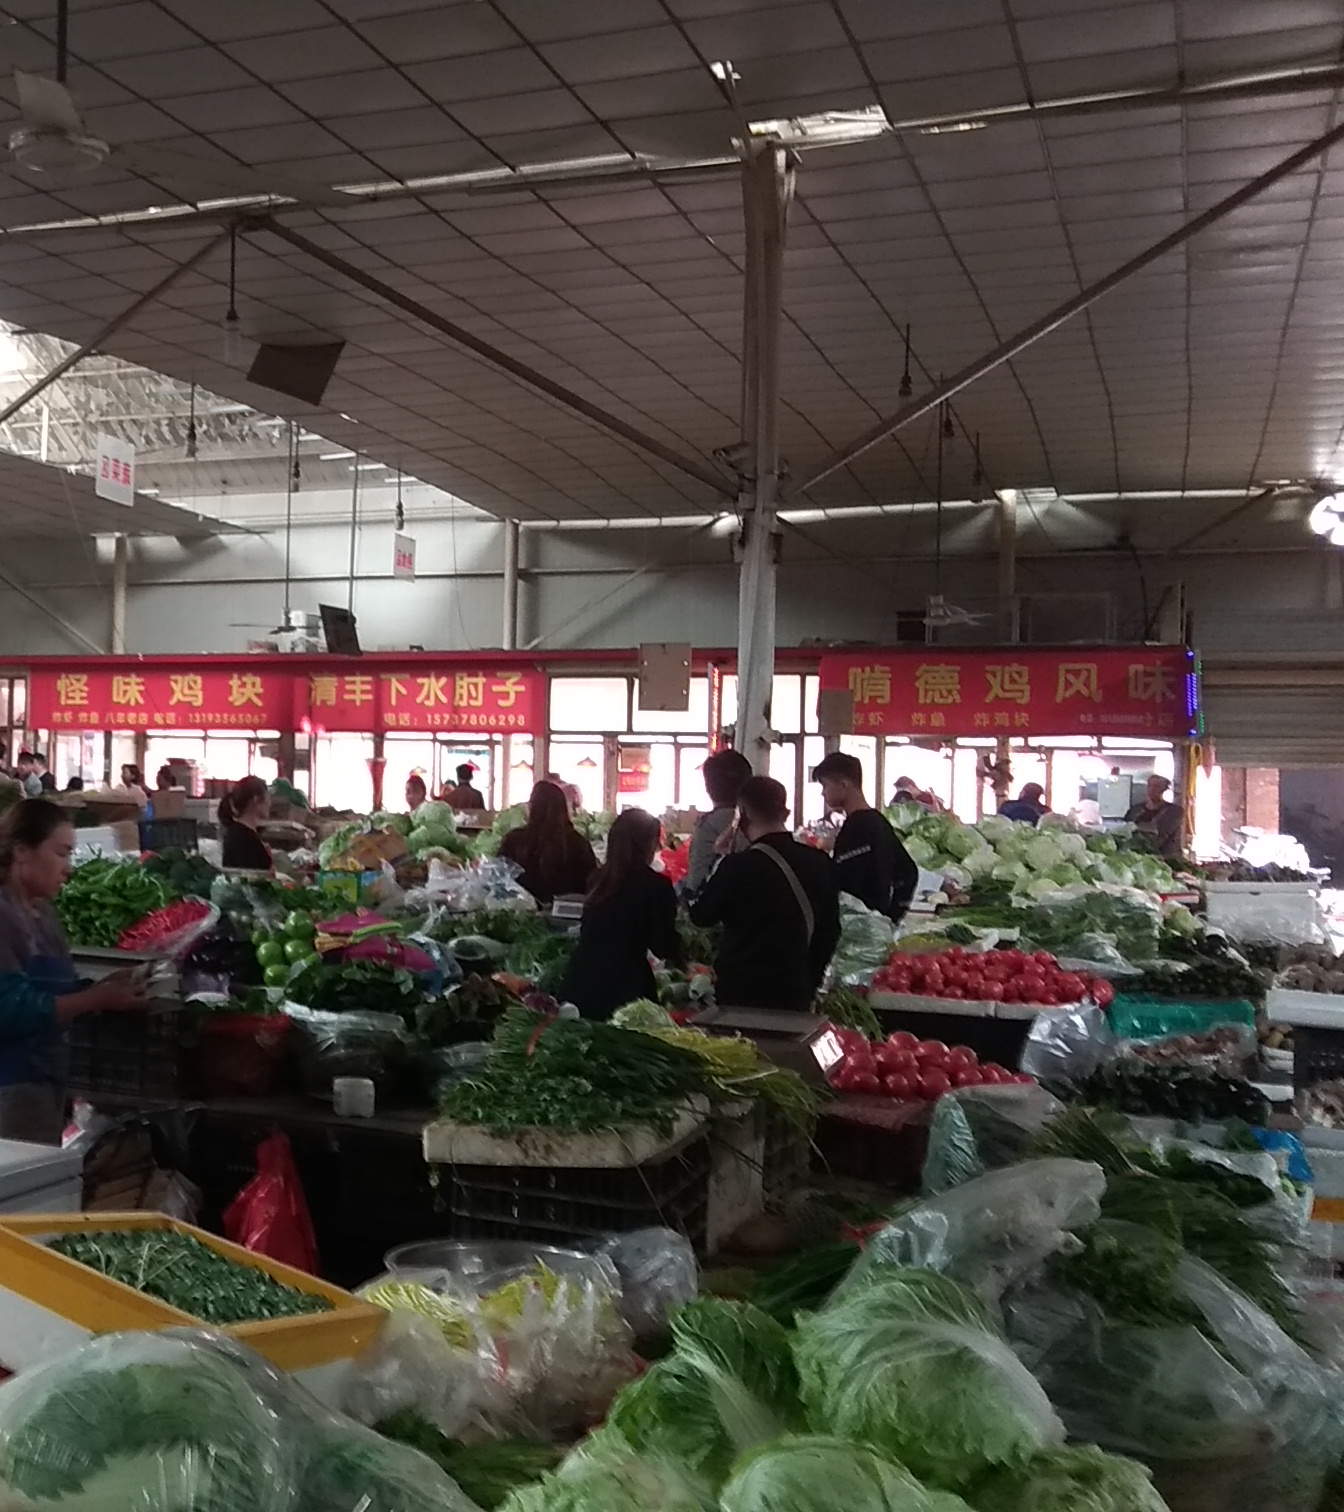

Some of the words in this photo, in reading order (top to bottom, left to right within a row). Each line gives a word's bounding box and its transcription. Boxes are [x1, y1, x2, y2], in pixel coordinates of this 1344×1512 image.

[57, 673, 264, 706] 怪味鸡块
[848, 663, 1175, 704] 啃德鸡风味
